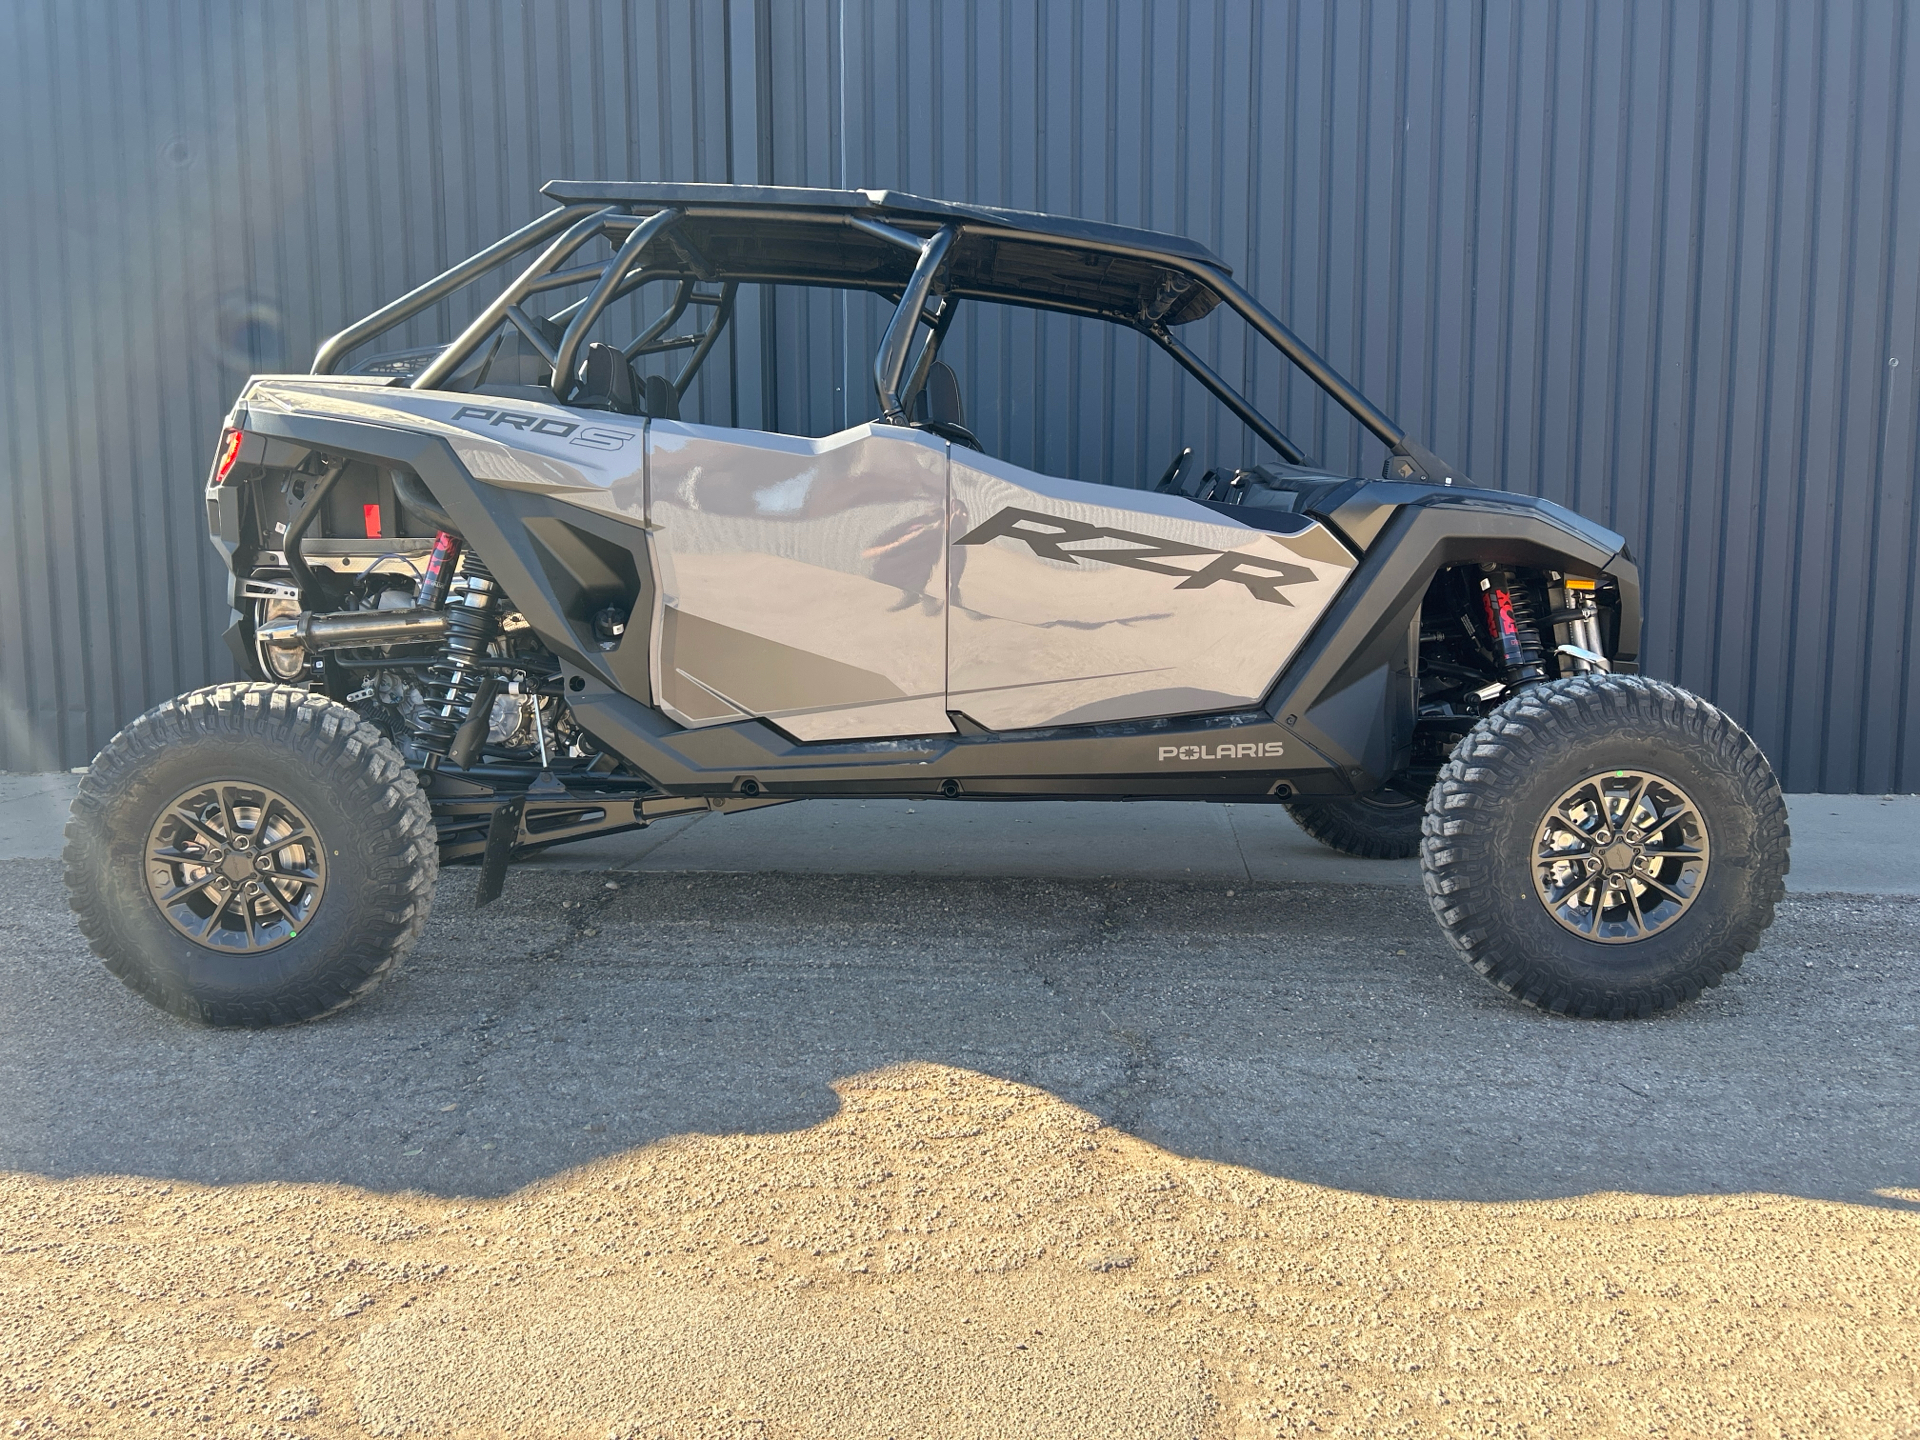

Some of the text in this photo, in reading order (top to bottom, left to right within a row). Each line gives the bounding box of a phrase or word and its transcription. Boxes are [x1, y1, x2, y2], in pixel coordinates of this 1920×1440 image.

[451, 406, 636, 451] PRO S
[951, 506, 1320, 608] RZR
[1495, 590, 1518, 634] FOX
[1158, 741, 1284, 761] POLARIS
